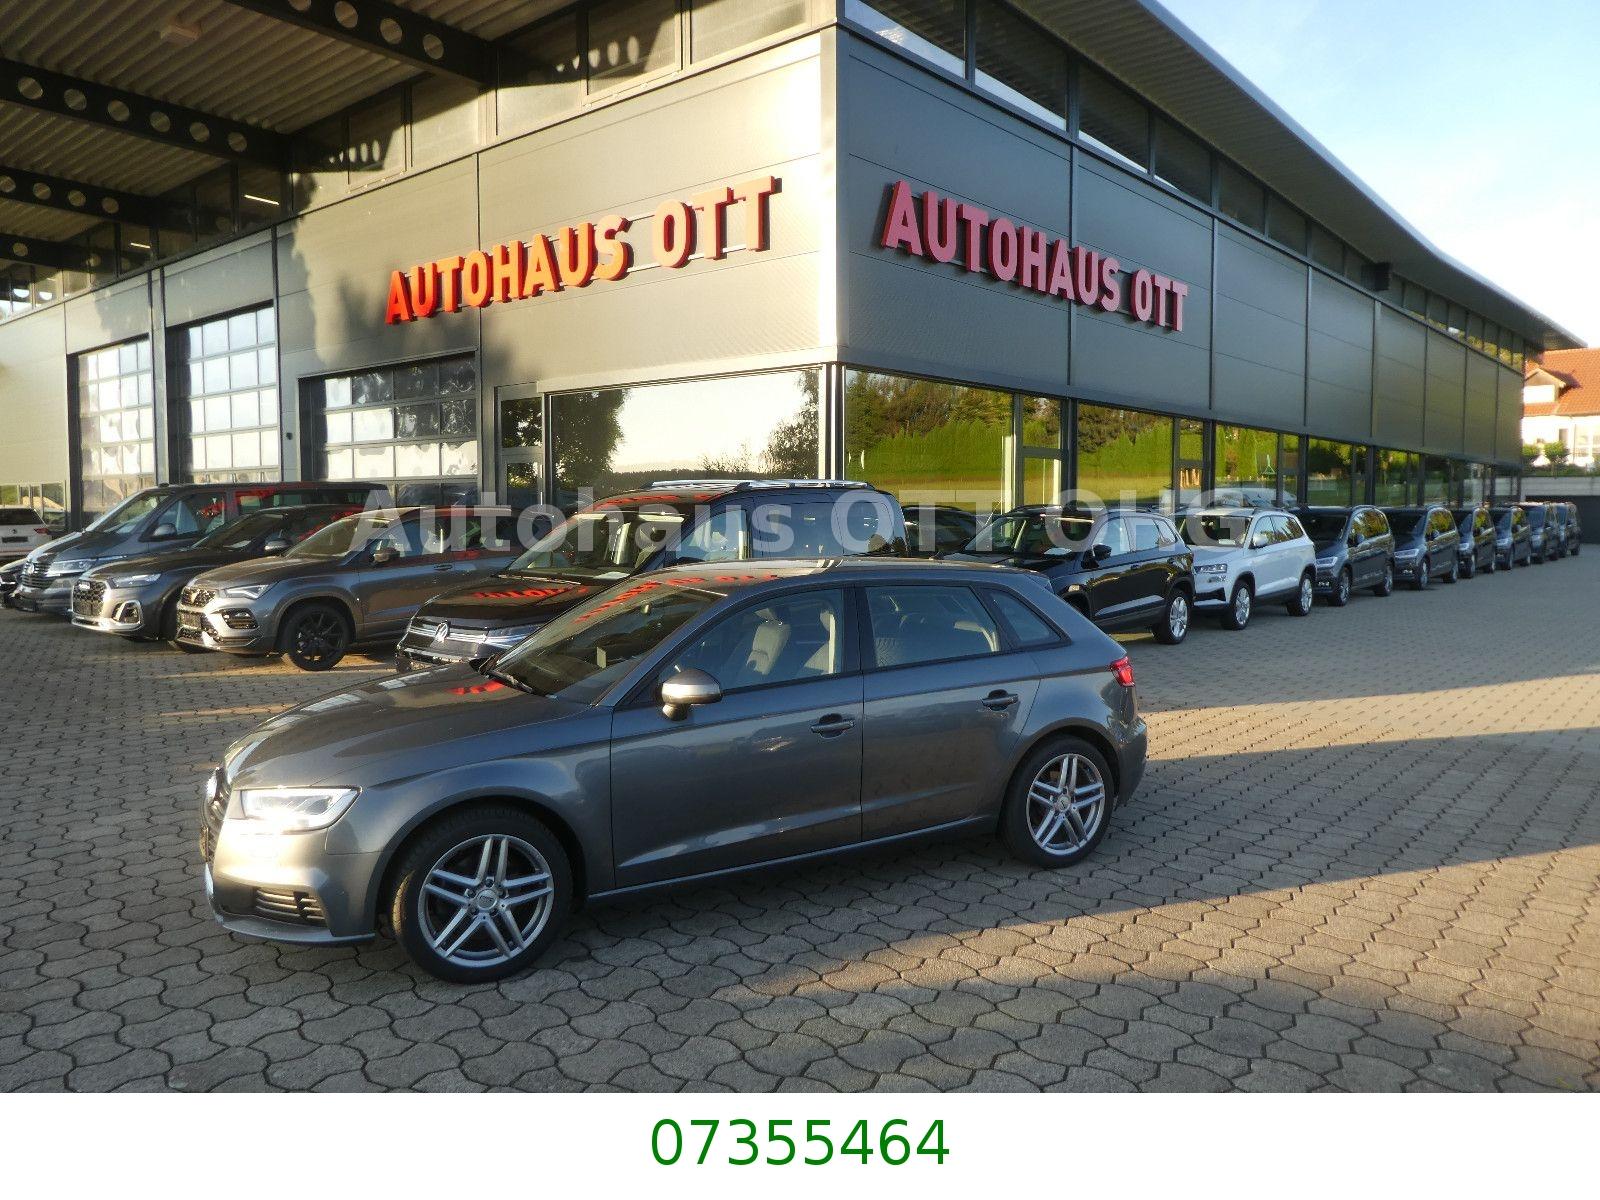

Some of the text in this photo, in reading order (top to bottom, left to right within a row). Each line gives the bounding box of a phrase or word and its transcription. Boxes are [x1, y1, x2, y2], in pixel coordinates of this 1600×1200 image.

[386, 176, 779, 324] AUTOHAUS OTT
[881, 180, 1188, 331] AUTOHAUS OTT
